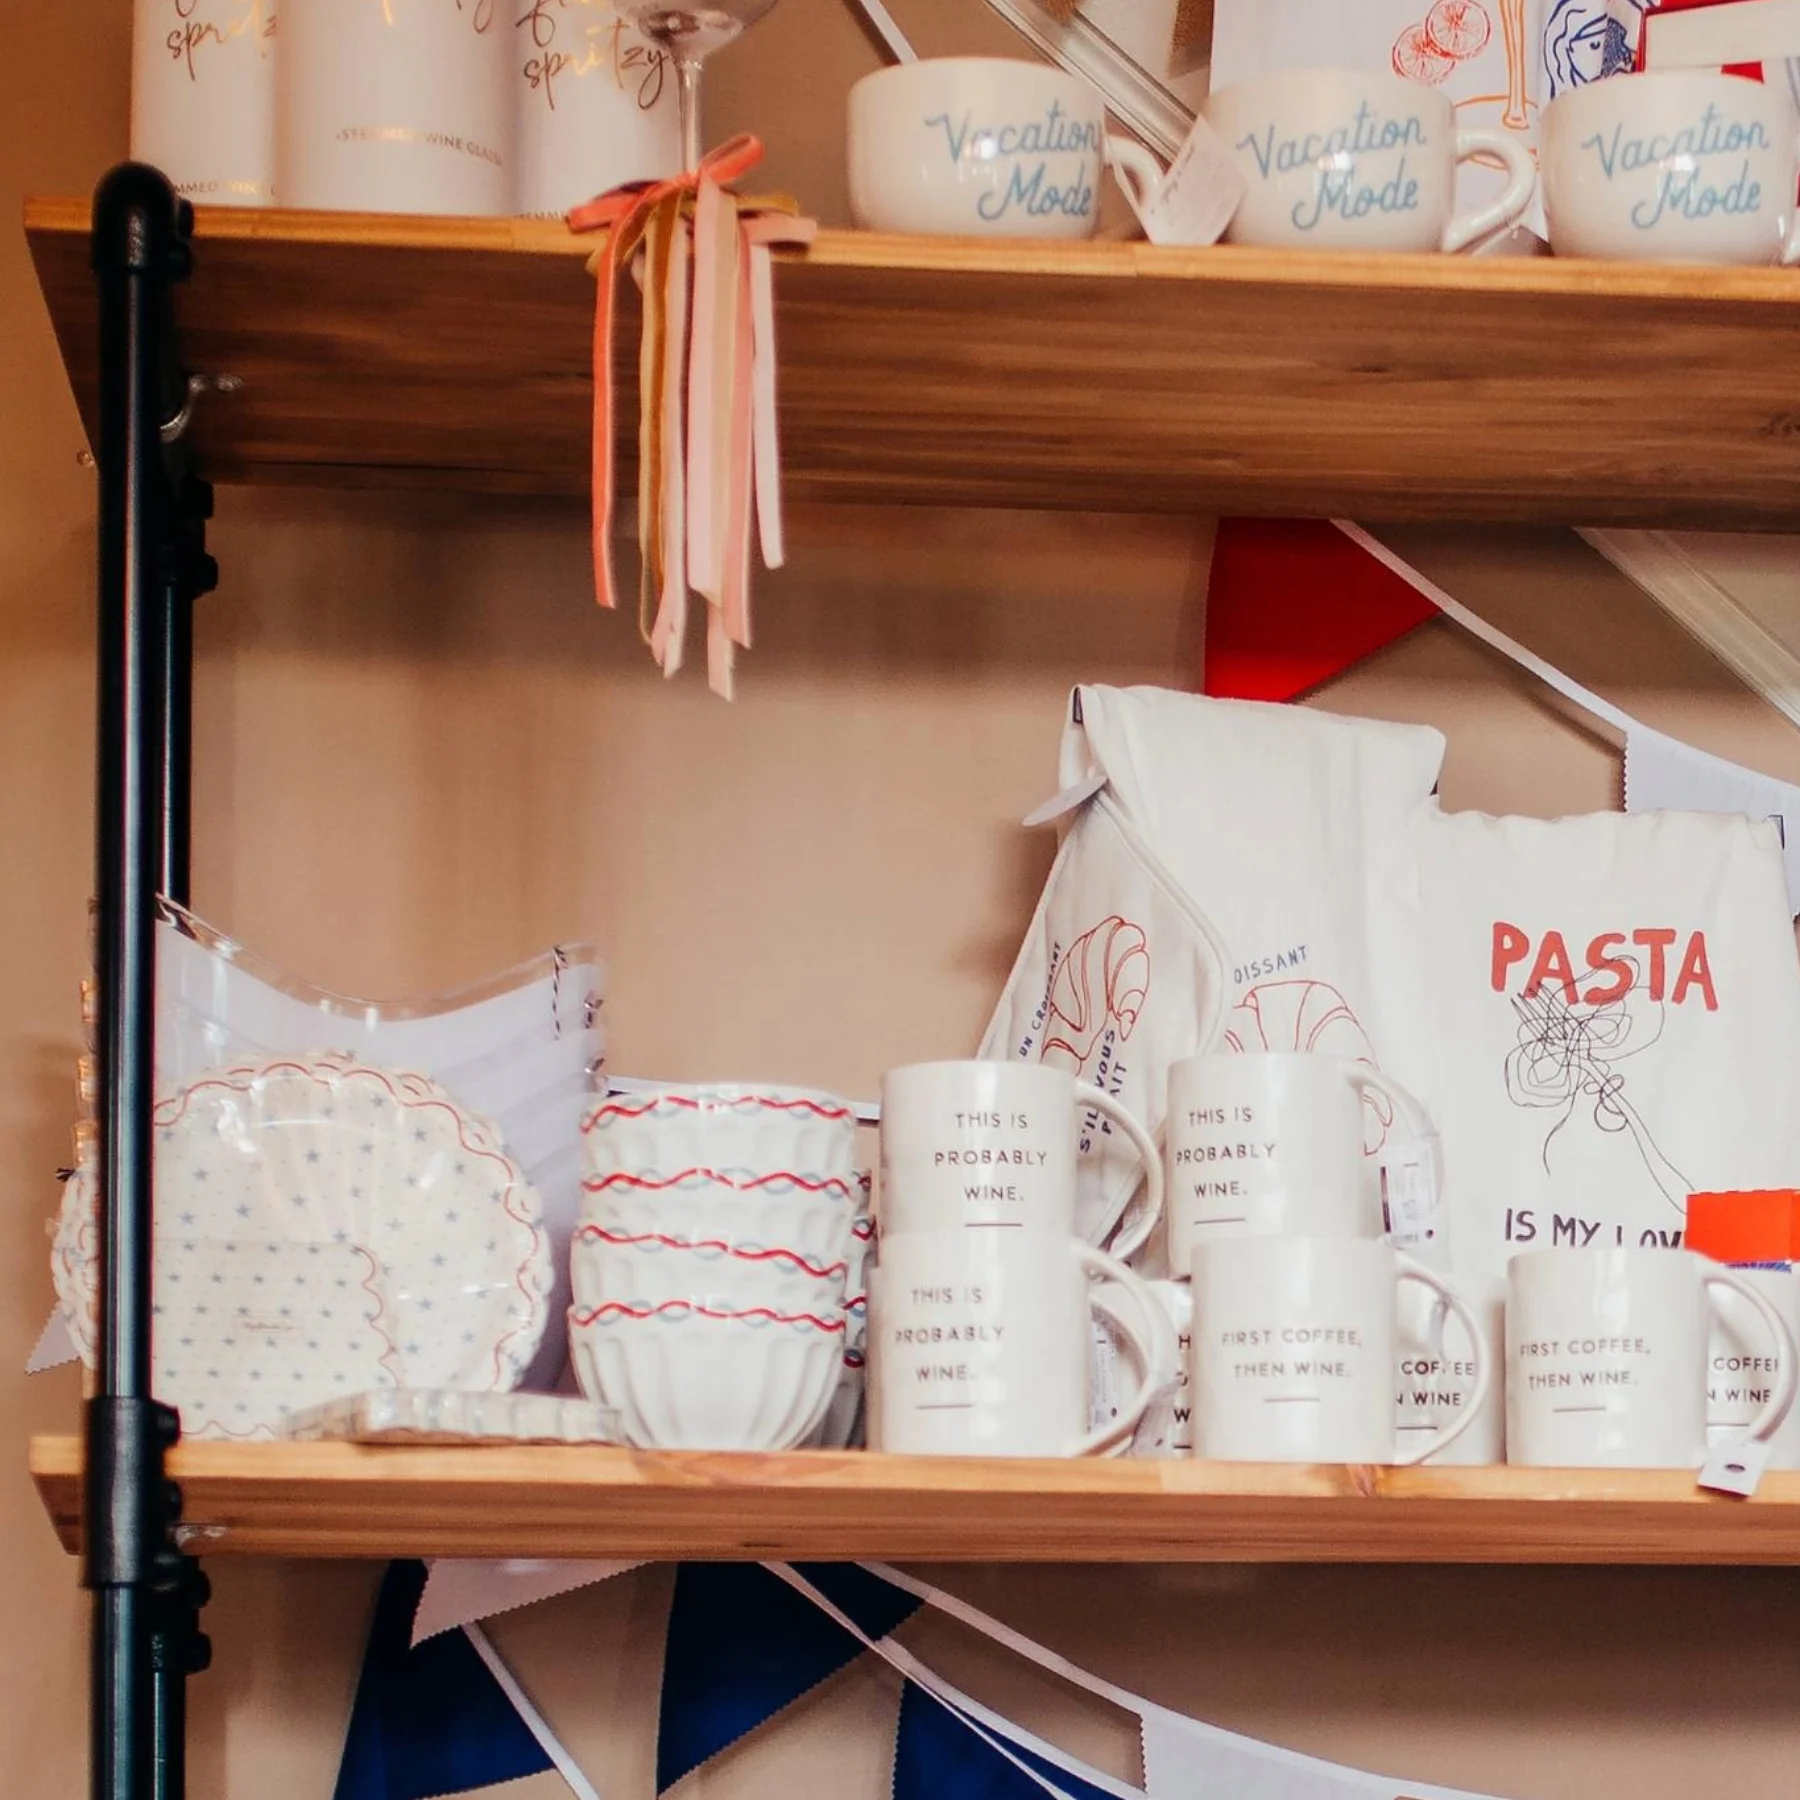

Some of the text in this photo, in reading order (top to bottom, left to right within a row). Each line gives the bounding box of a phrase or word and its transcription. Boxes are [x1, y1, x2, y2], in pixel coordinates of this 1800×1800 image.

[925, 100, 1099, 163] Vacation
[1236, 100, 1427, 178] Vacation
[1580, 102, 1771, 180] Vacation
[976, 162, 1093, 221] Mode
[1292, 158, 1420, 230] Mode
[1630, 160, 1762, 230] Mode
[1233, 945, 1310, 985] OISSANT
[1490, 921, 1719, 1012] PASTA
[1094, 1028, 1116, 1088] VOUS
[954, 1113, 1028, 1129] THIS IS
[1189, 1107, 1252, 1126] THIS IS
[934, 1150, 1048, 1167] PROBABLY
[1176, 1143, 1276, 1166] PROBABLY
[964, 1186, 1024, 1201] WINE.
[1193, 1181, 1248, 1198] WINE.
[1504, 1208, 1601, 1248] IS MY
[910, 1287, 982, 1304] THIS IS
[895, 1325, 1004, 1344] PROBABLY
[1221, 1330, 1272, 1348] FIRST
[1519, 1342, 1559, 1358] FIRST
[1233, 1362, 1286, 1379] THEN
[1529, 1373, 1571, 1391] THEN
